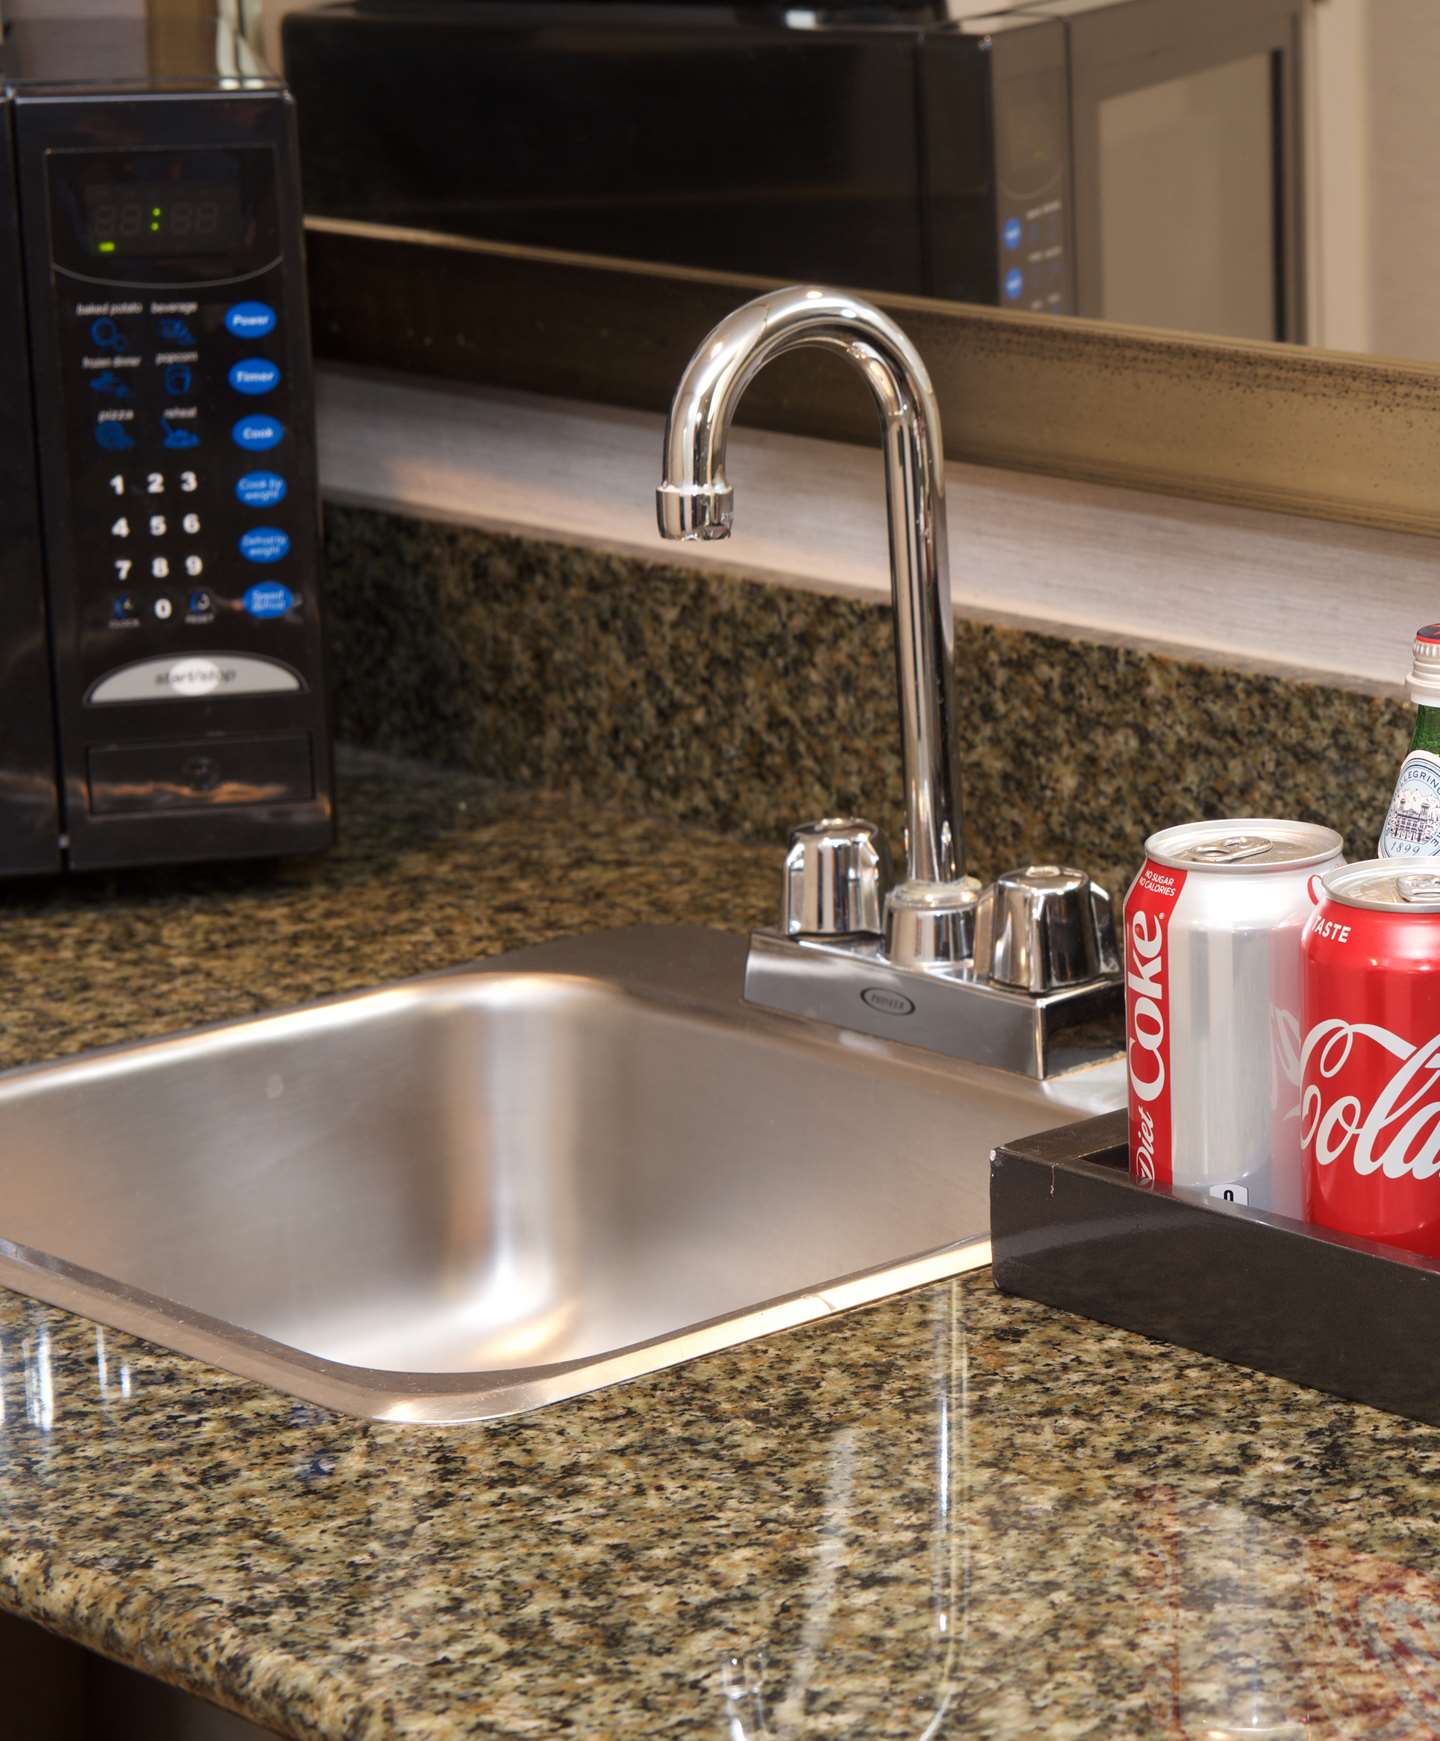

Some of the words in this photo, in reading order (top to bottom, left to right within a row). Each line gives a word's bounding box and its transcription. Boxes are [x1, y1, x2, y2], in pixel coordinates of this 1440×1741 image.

[232, 314, 269, 327] Power
[237, 371, 274, 383] Timer
[98, 409, 134, 422] pizza
[110, 475, 125, 494] 1
[148, 473, 164, 493] 2
[181, 471, 197, 492] 3
[112, 517, 129, 537] 4
[150, 515, 166, 535] 5
[183, 513, 200, 533] 6
[115, 560, 131, 580] 7
[152, 557, 169, 577] 8
[186, 555, 202, 575] 9
[154, 598, 172, 619] 0
[1144, 880, 1176, 897] CALORIES
[1152, 872, 1175, 887] SUGAR
[1310, 915, 1352, 944] TASTE
[1127, 909, 1165, 1102] Coke
[1134, 1105, 1155, 1186] Diet
